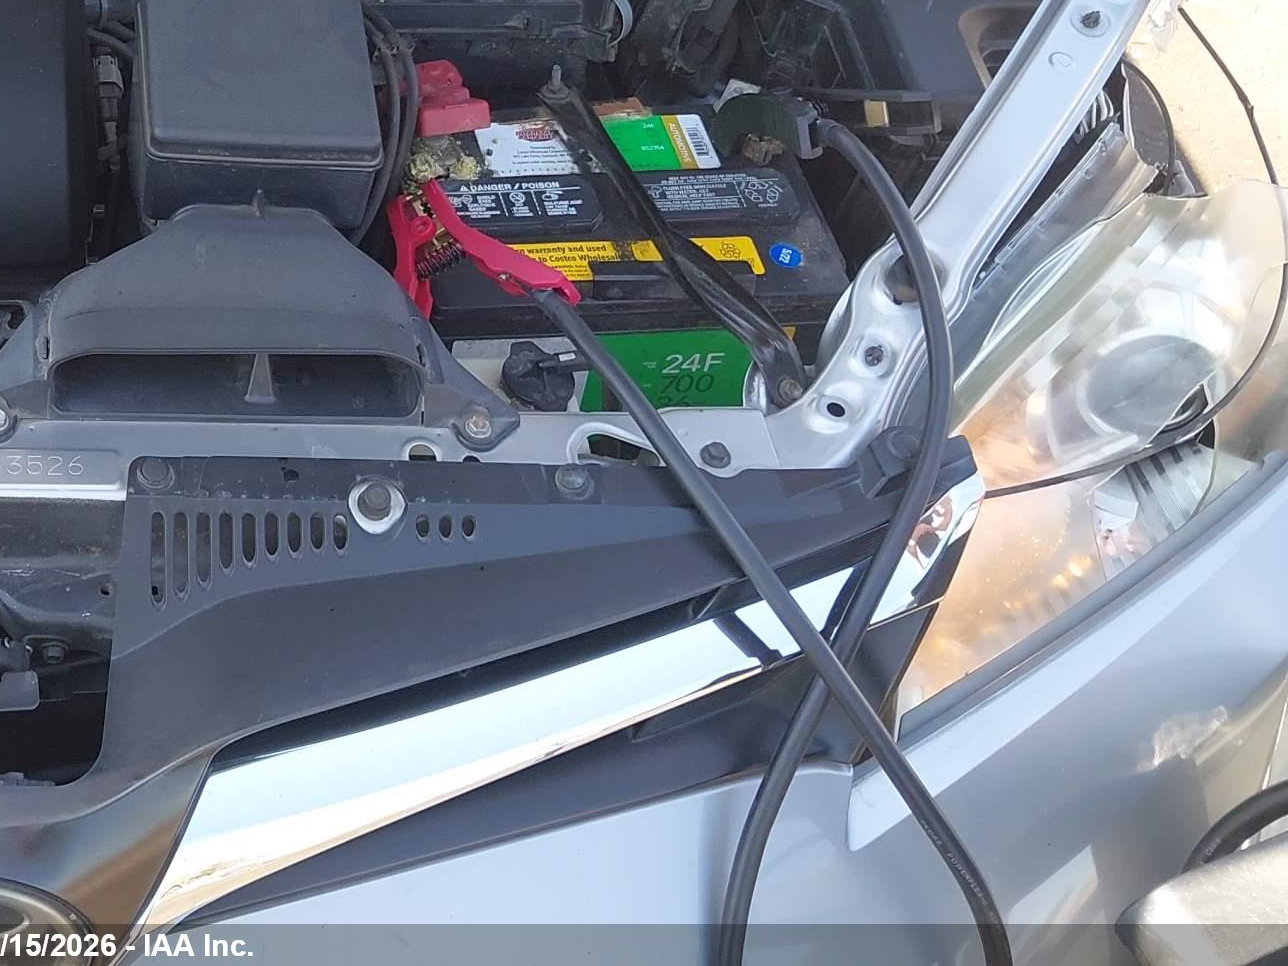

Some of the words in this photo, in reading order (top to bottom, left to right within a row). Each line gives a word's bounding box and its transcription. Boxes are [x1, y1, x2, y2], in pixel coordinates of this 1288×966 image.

[470, 184, 511, 192] DANGER
[522, 181, 559, 189] POISON
[528, 246, 566, 254] warranty
[568, 244, 583, 252] and
[586, 244, 606, 252] used
[549, 254, 576, 262] Costco
[662, 352, 726, 374] 24F
[660, 373, 715, 394] 700
